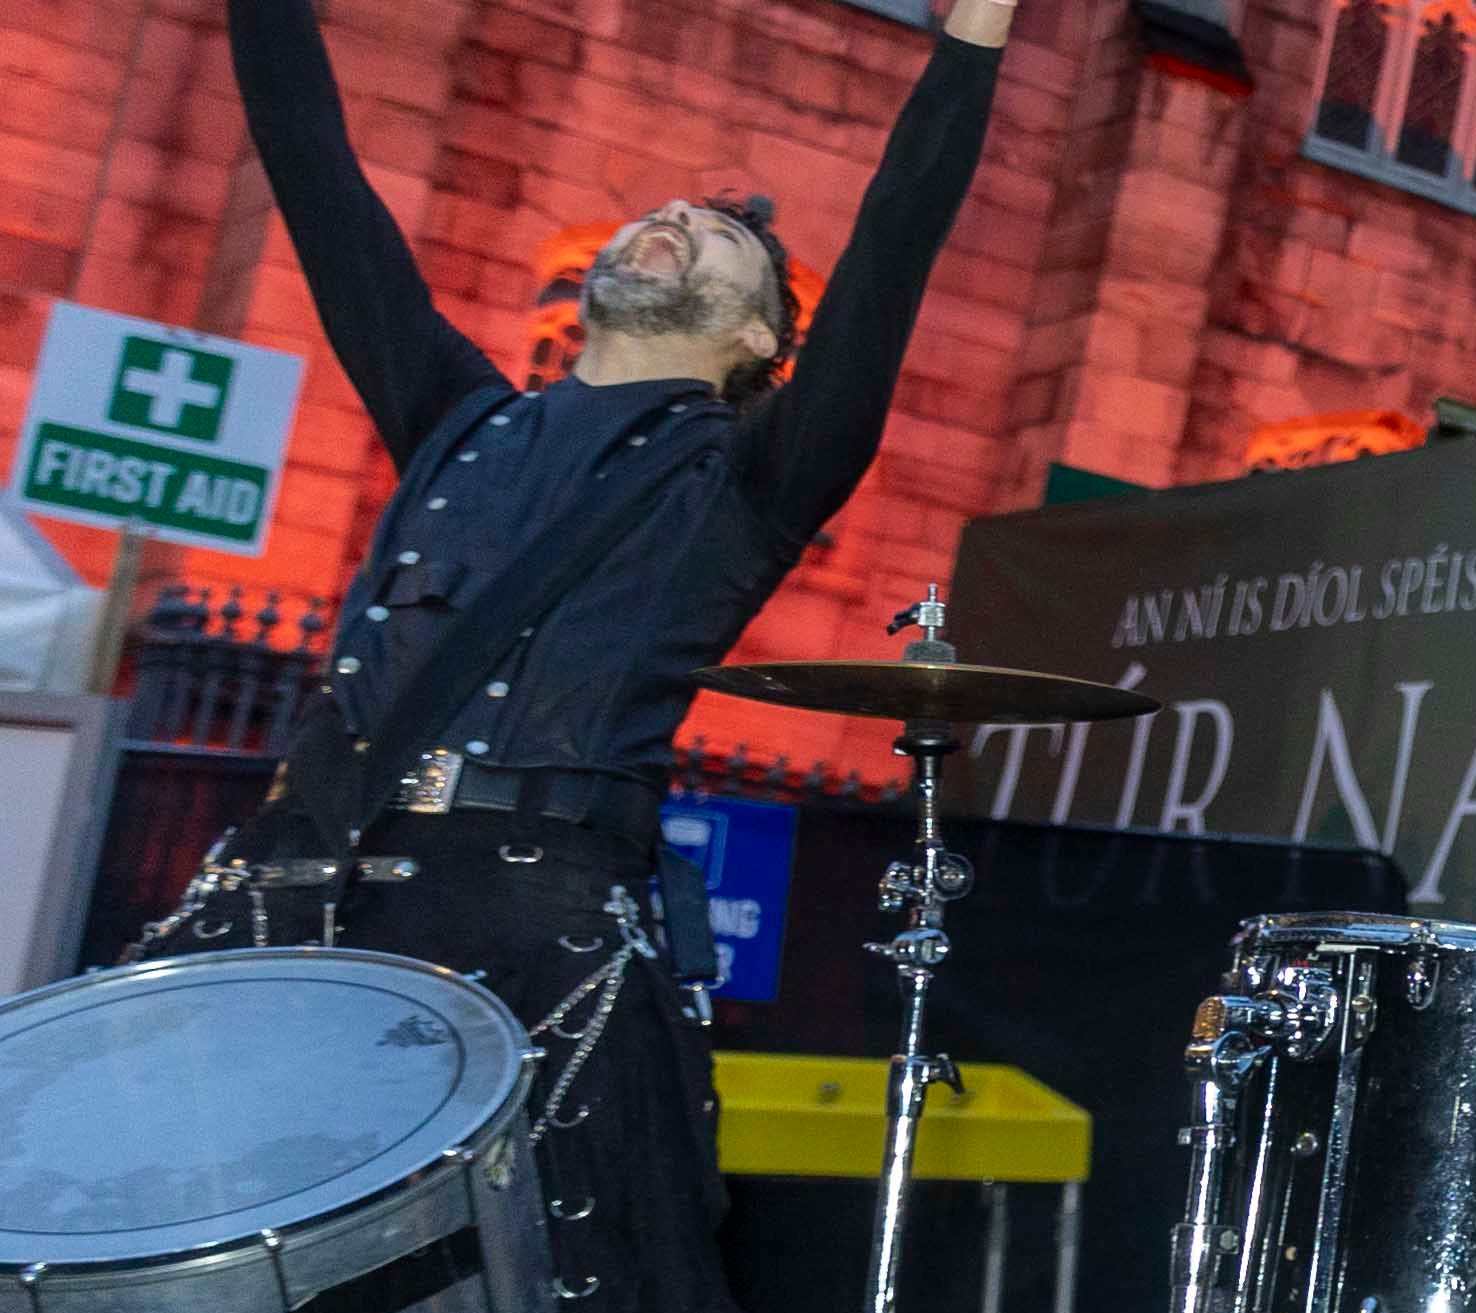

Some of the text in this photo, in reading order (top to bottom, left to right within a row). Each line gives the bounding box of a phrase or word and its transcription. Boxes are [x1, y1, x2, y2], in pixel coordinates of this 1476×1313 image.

[35, 439, 260, 526] FIRST AID
[1112, 587, 1174, 648] AN
[1227, 576, 1268, 637] IS
[1269, 560, 1367, 631] DÍOL
